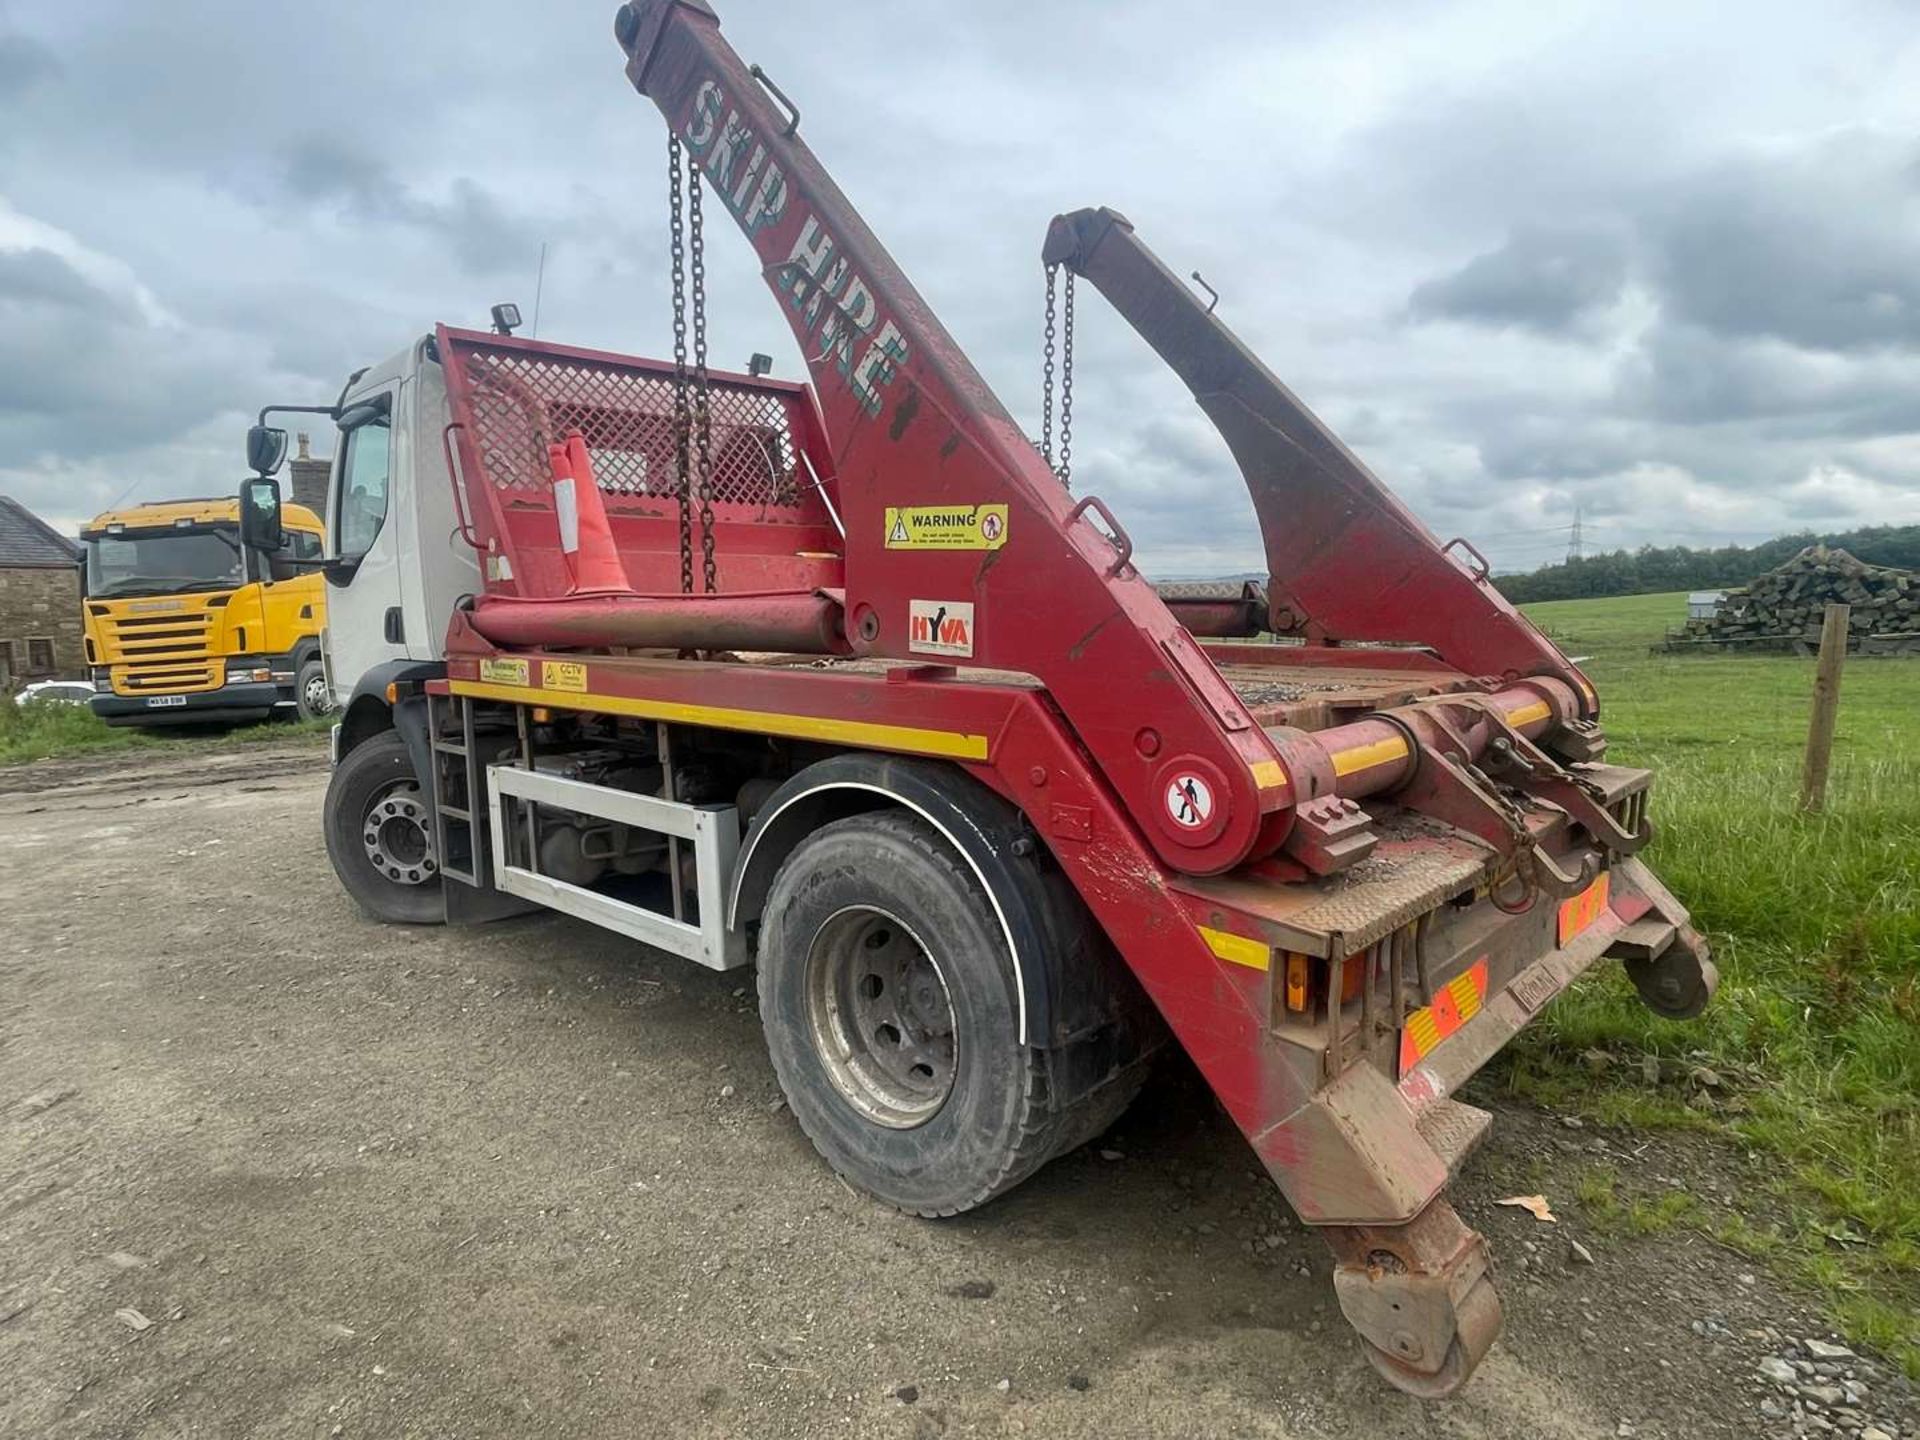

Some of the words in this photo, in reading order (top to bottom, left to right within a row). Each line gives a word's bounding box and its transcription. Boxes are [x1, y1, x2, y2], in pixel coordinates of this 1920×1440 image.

[686, 81, 788, 233] SKIP
[779, 214, 909, 415] HIRE
[912, 514, 976, 527] WARNING
[912, 607, 968, 645] HYVA
[560, 664, 582, 675] CCTV
